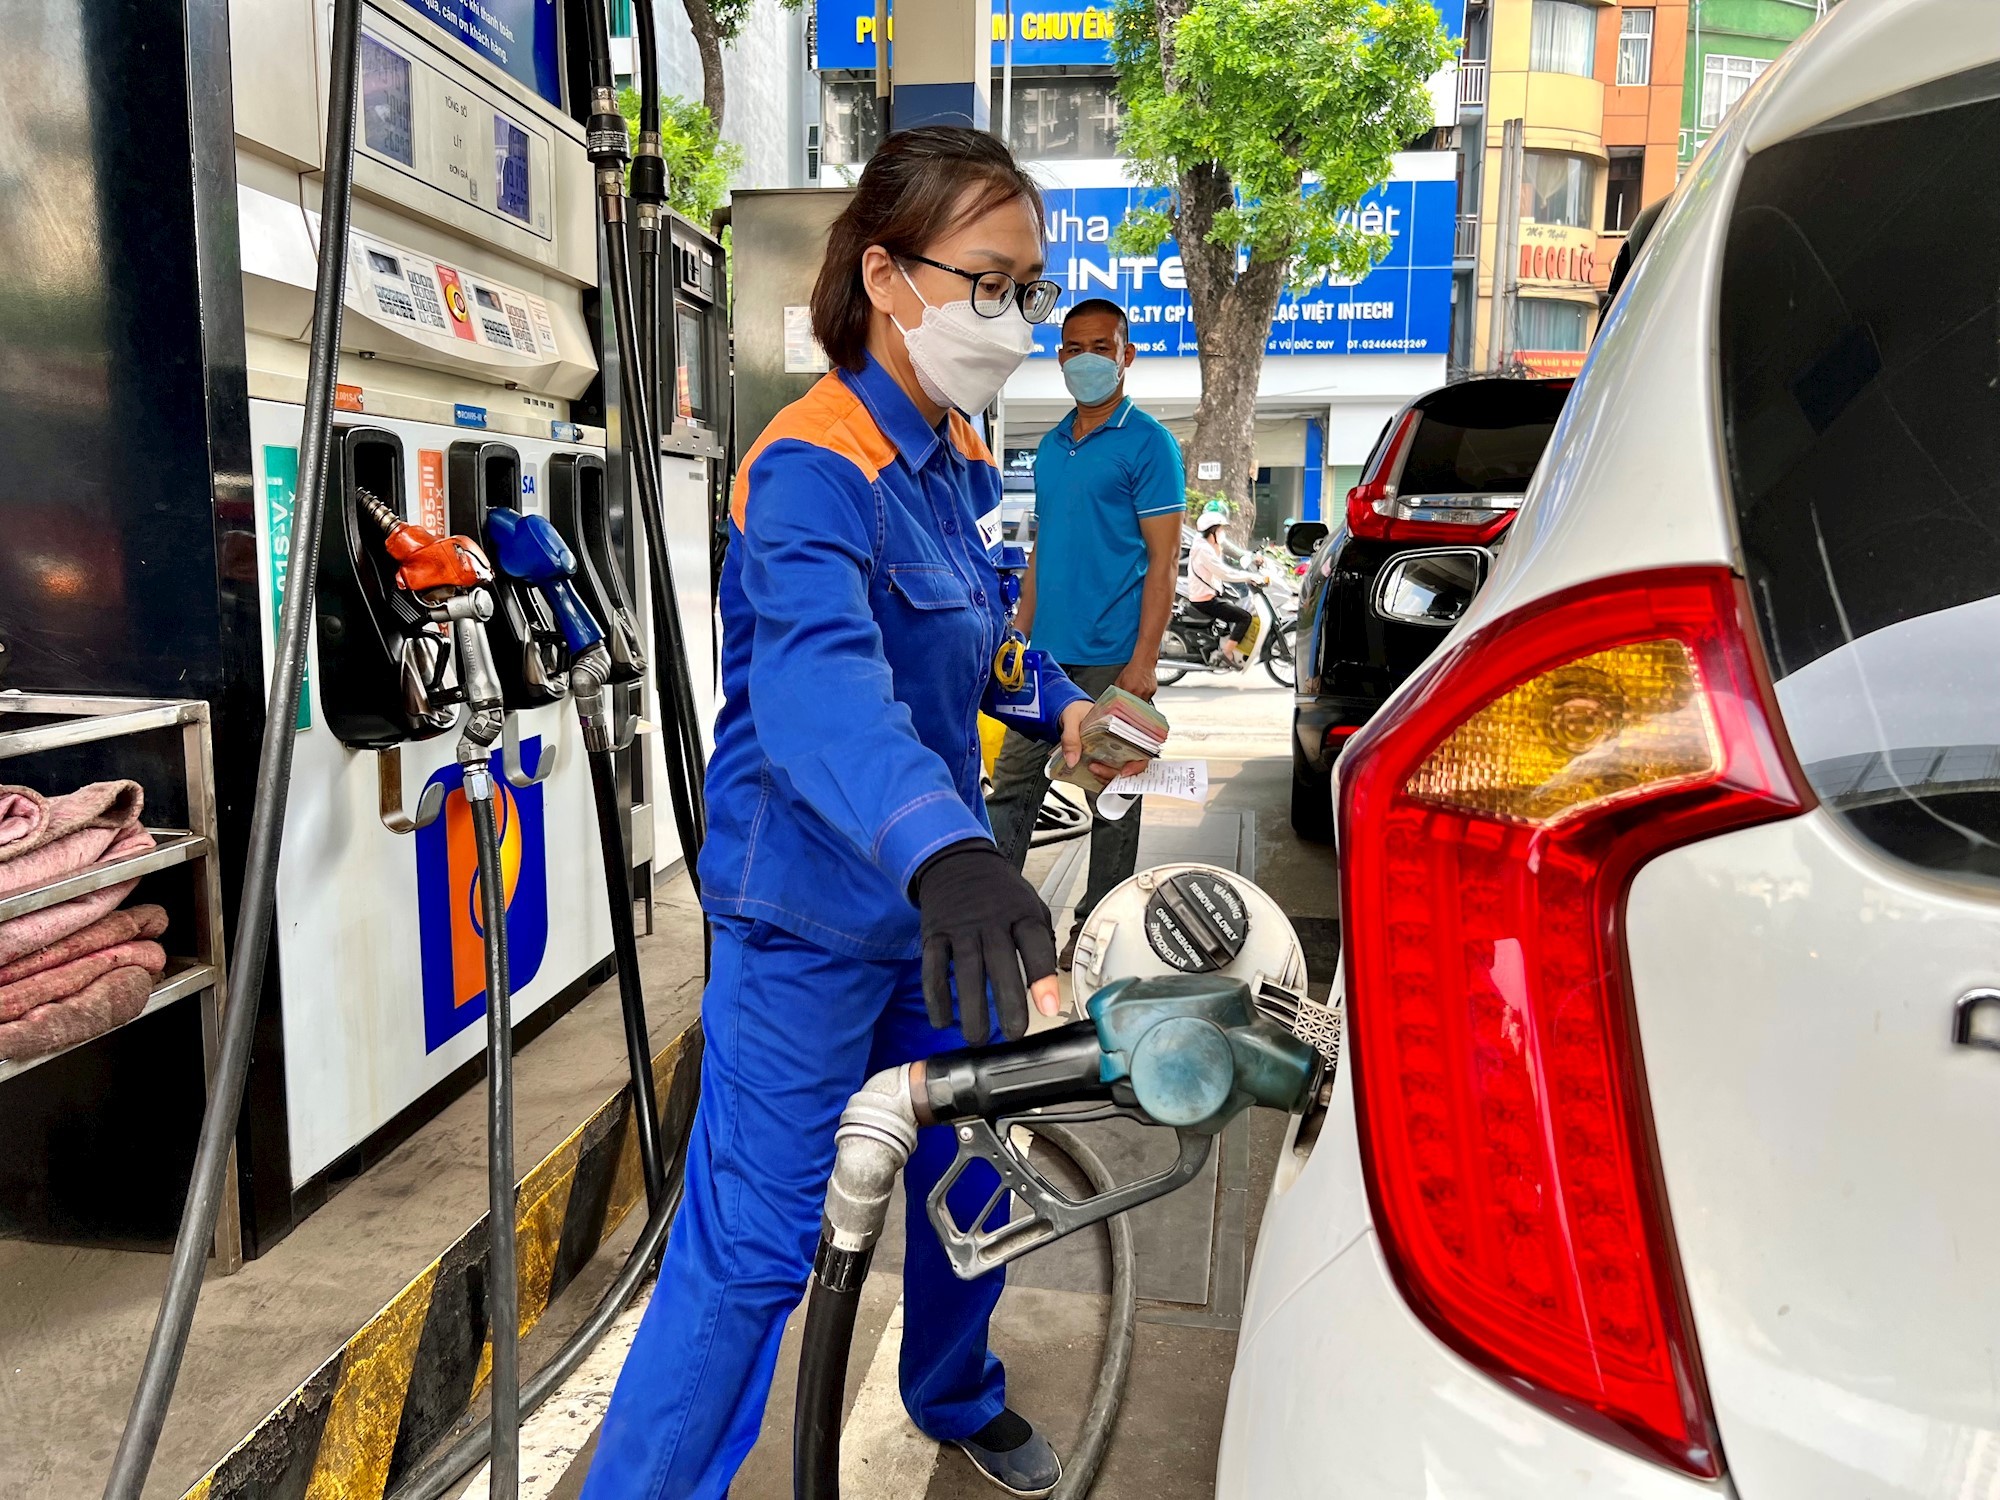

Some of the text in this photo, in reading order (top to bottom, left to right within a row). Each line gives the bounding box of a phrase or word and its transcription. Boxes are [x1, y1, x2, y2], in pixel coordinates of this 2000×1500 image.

[469, 22, 490, 49] khách
[1021, 5, 1115, 40] CHUYÊN
[1129, 305, 1162, 323] C.TY
[1164, 305, 1186, 323] CP
[1301, 299, 1335, 325] VIỆT
[1337, 301, 1394, 321] INTECH
[1316, 340, 1334, 350] DUY
[422, 465, 437, 537] 95-III
[1189, 881, 1239, 941] REMOVE SLOWLY
[1212, 883, 1242, 919] WARNING
[1150, 922, 1188, 968] ATTENZIONE
[1155, 907, 1204, 968] RIMUOVERE PIANO
